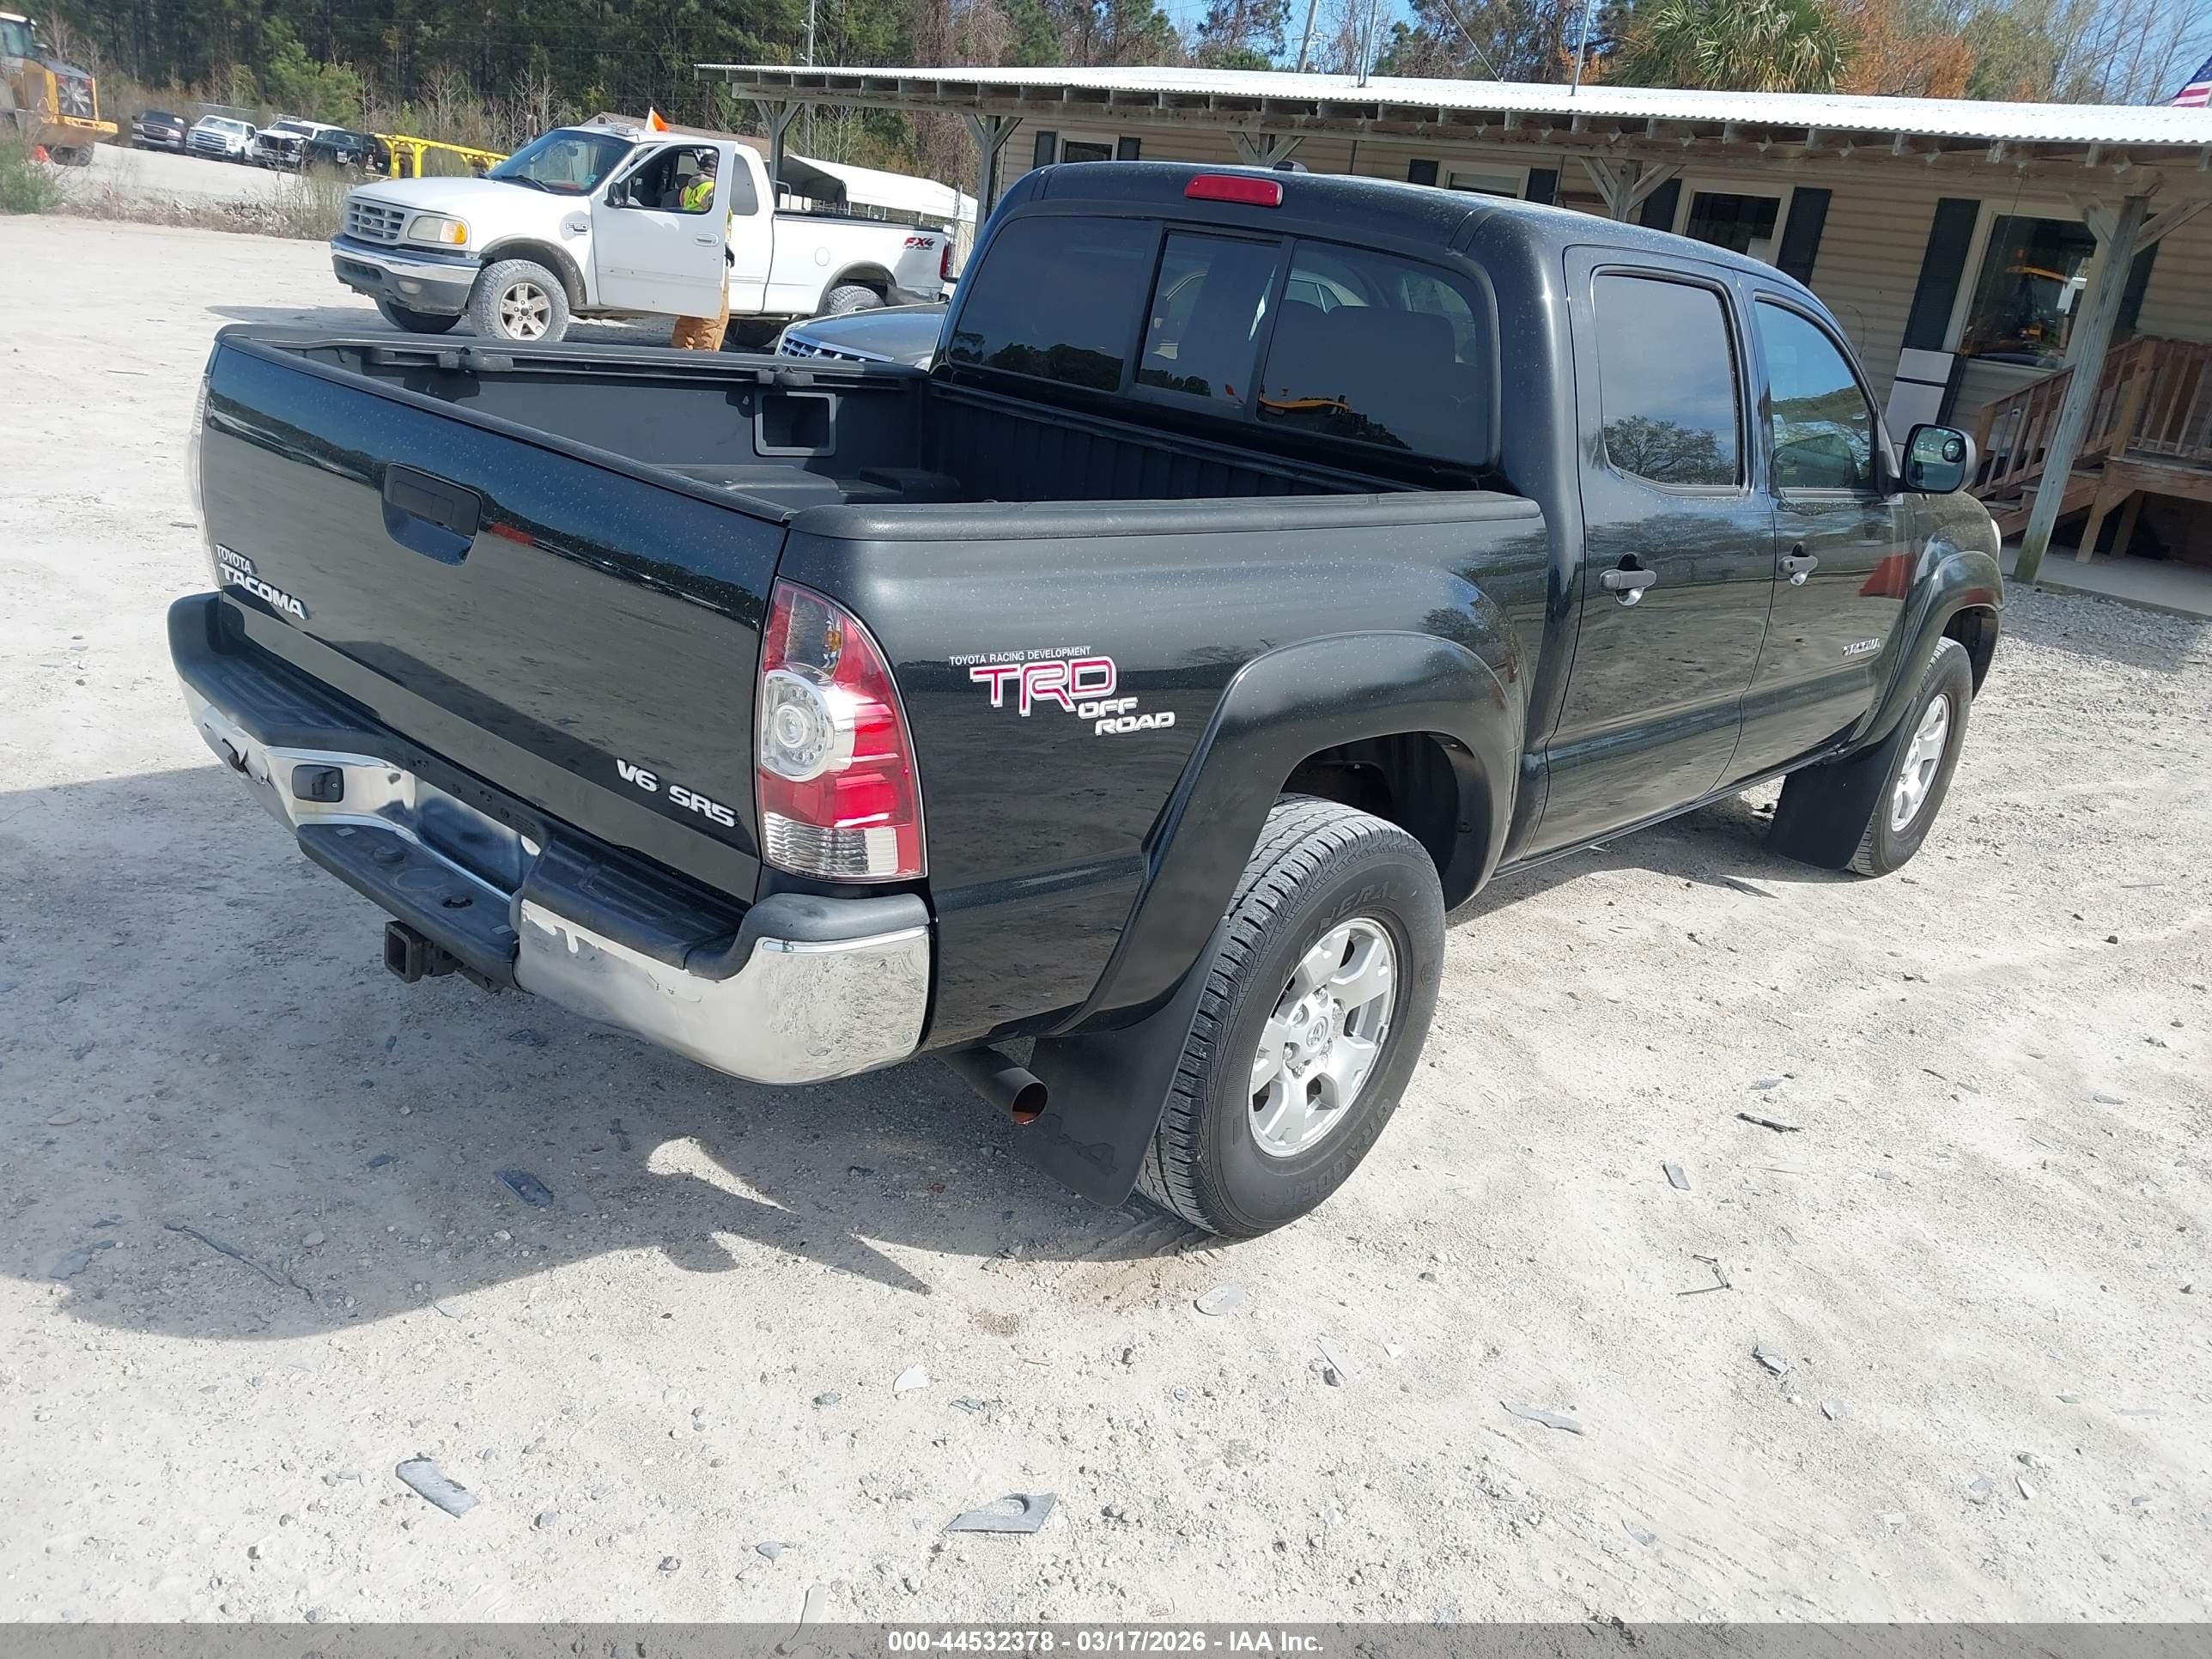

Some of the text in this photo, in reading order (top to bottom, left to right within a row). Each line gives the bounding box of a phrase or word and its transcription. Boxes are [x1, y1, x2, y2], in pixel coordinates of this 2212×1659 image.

[903, 237, 935, 246] FX4
[215, 543, 254, 574] TOYOTA
[219, 562, 307, 620] TACOMA
[949, 646, 1091, 666] TOYOTA RACING DEVELOPMENT
[969, 656, 1116, 716] TRD
[1078, 697, 1139, 720] OFF
[1095, 711, 1176, 736] ROAD
[617, 758, 738, 828] V6 SR5
